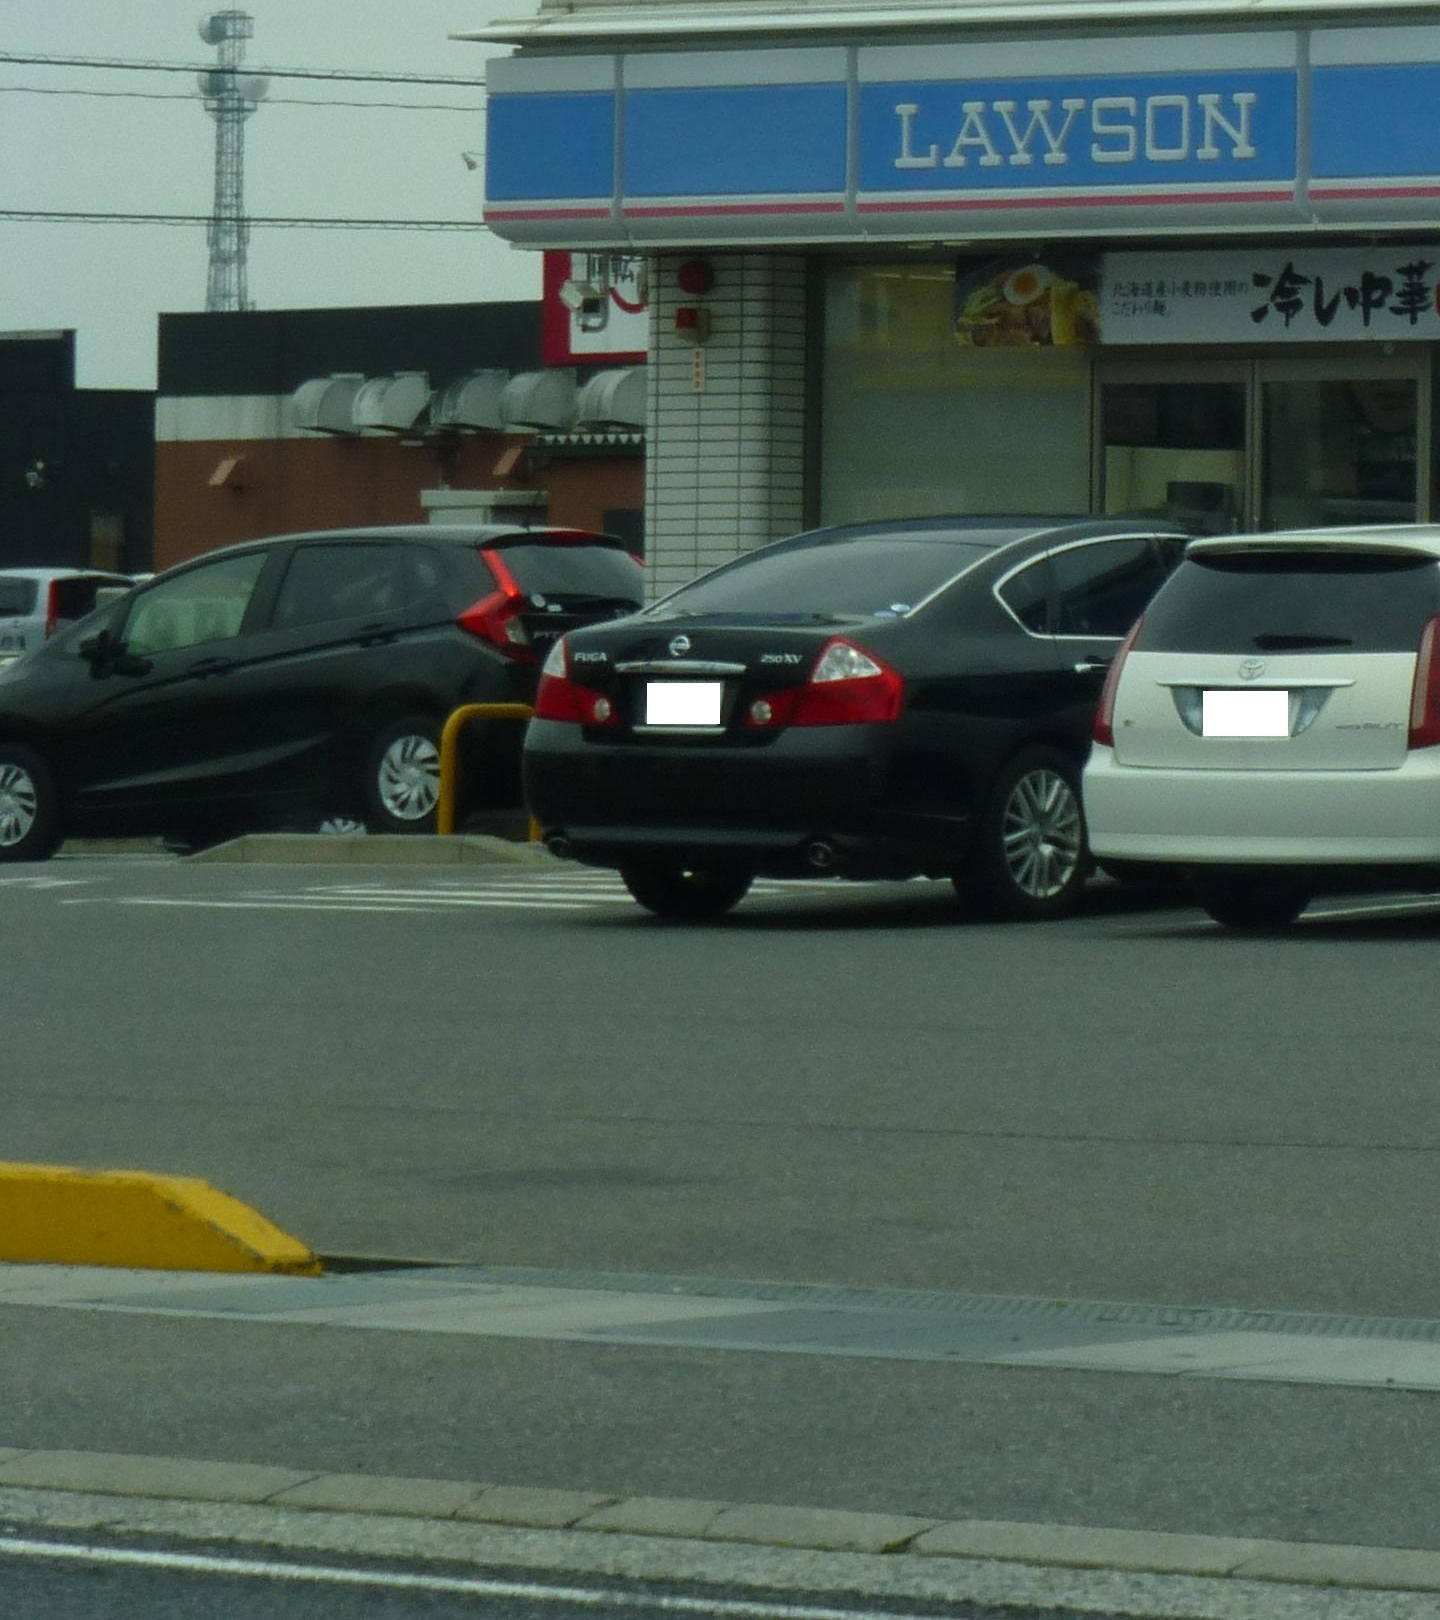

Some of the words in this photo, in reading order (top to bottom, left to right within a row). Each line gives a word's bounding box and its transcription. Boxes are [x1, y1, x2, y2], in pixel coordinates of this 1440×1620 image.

[894, 92, 1257, 169] LAWSON
[1250, 259, 1435, 328] 冷し中華
[573, 651, 608, 662] FUGA
